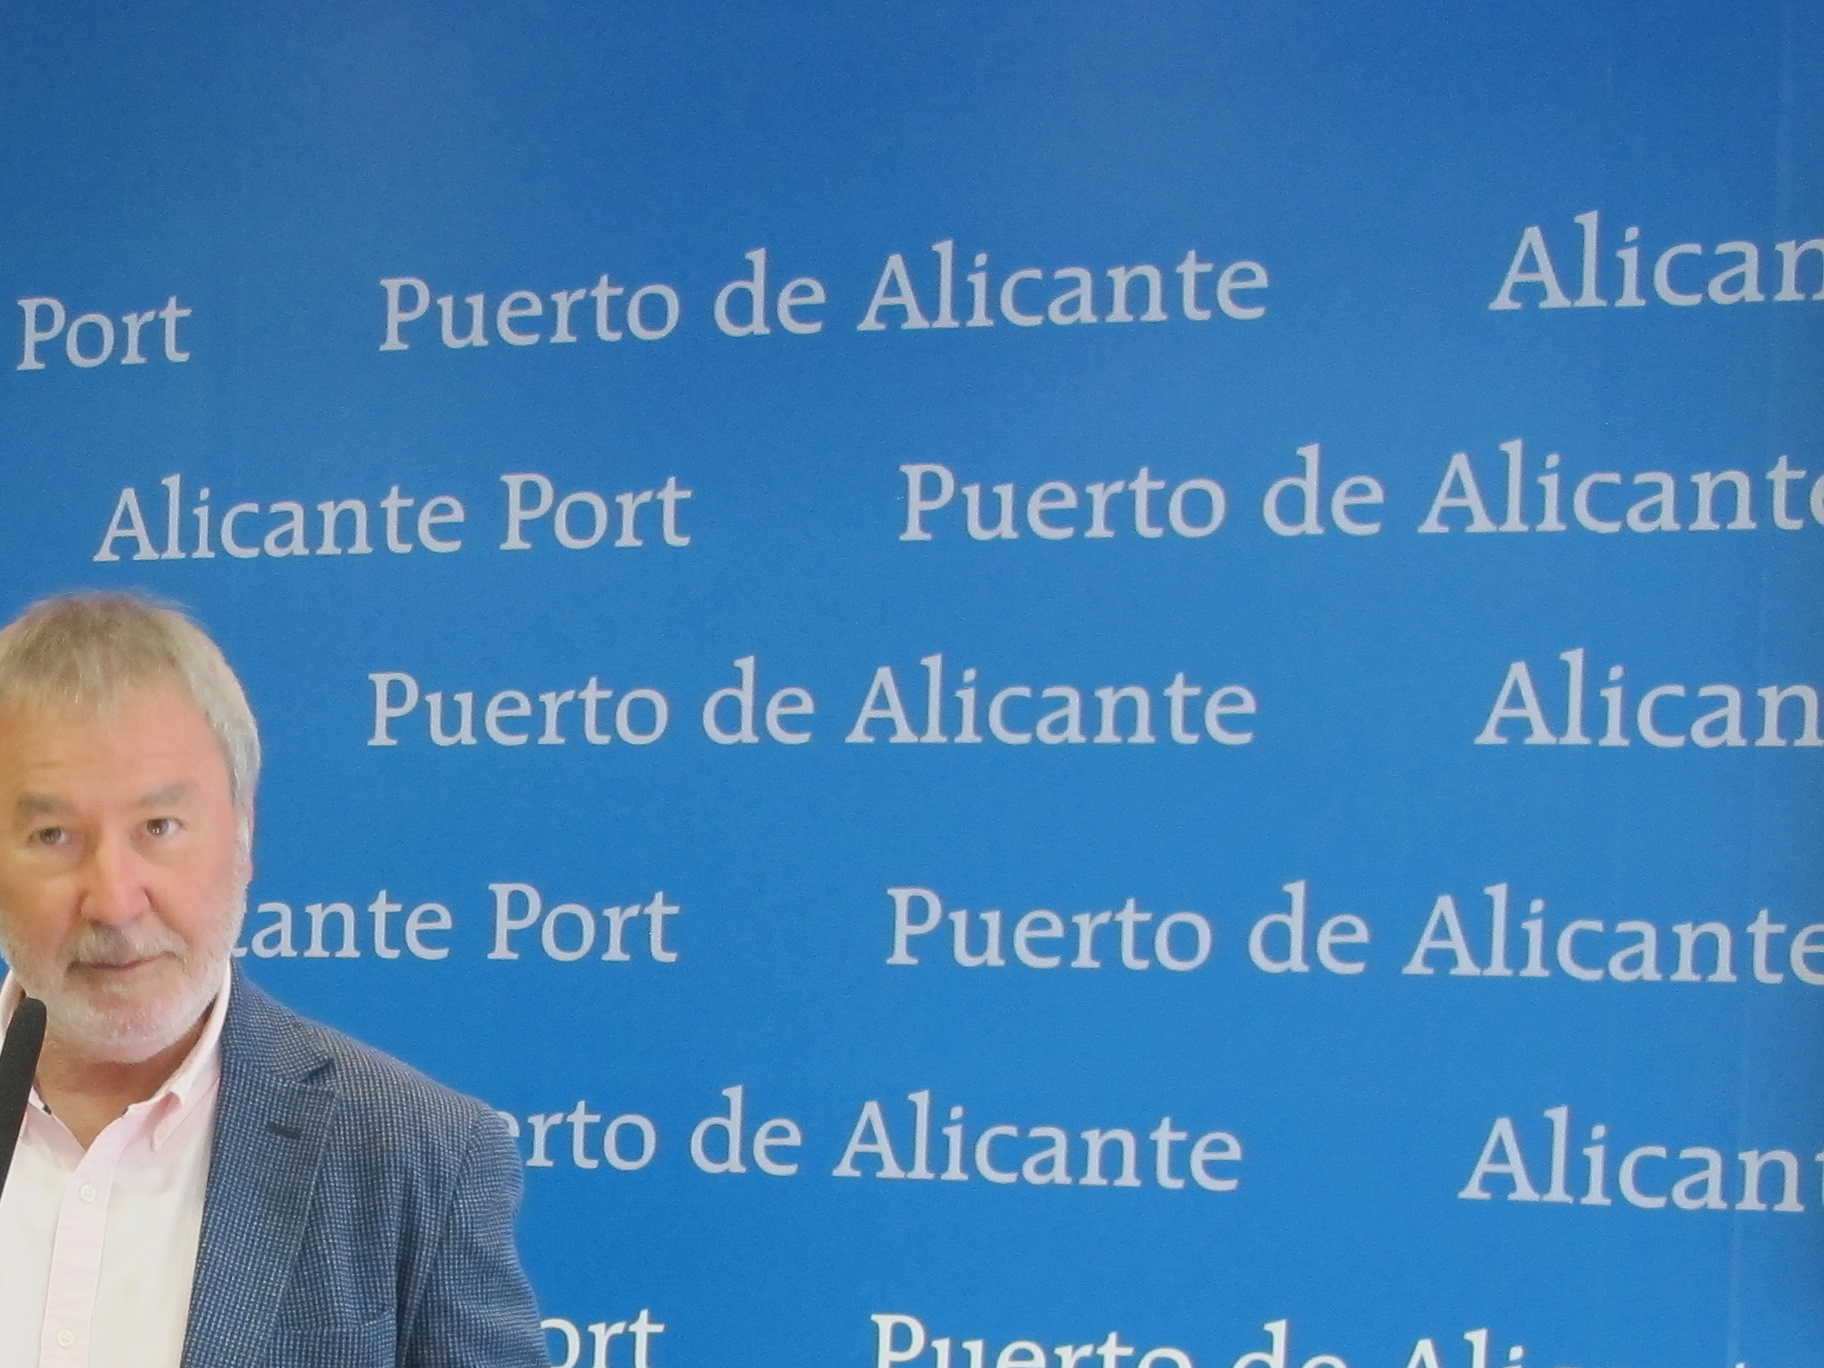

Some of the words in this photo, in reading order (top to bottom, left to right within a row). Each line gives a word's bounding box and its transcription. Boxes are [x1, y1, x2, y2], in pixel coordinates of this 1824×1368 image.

[17, 296, 192, 370] Port
[380, 275, 680, 350] Puerto
[715, 248, 826, 336] de
[858, 240, 1270, 330] Alicante
[93, 473, 465, 561] Alicante
[500, 472, 693, 550] Port
[900, 464, 1226, 540] Puerto
[1263, 444, 1385, 536] de
[1418, 439, 1824, 533] Alicant
[368, 672, 669, 746] Puerto
[703, 656, 815, 744] de
[846, 654, 1257, 744] Alicante
[488, 883, 680, 962] Port
[887, 887, 1212, 971] Puerto
[1249, 880, 1370, 974] de
[691, 1085, 802, 1176] de
[833, 1090, 1242, 1191] Alicante
[1459, 1106, 1824, 1212] Alican
